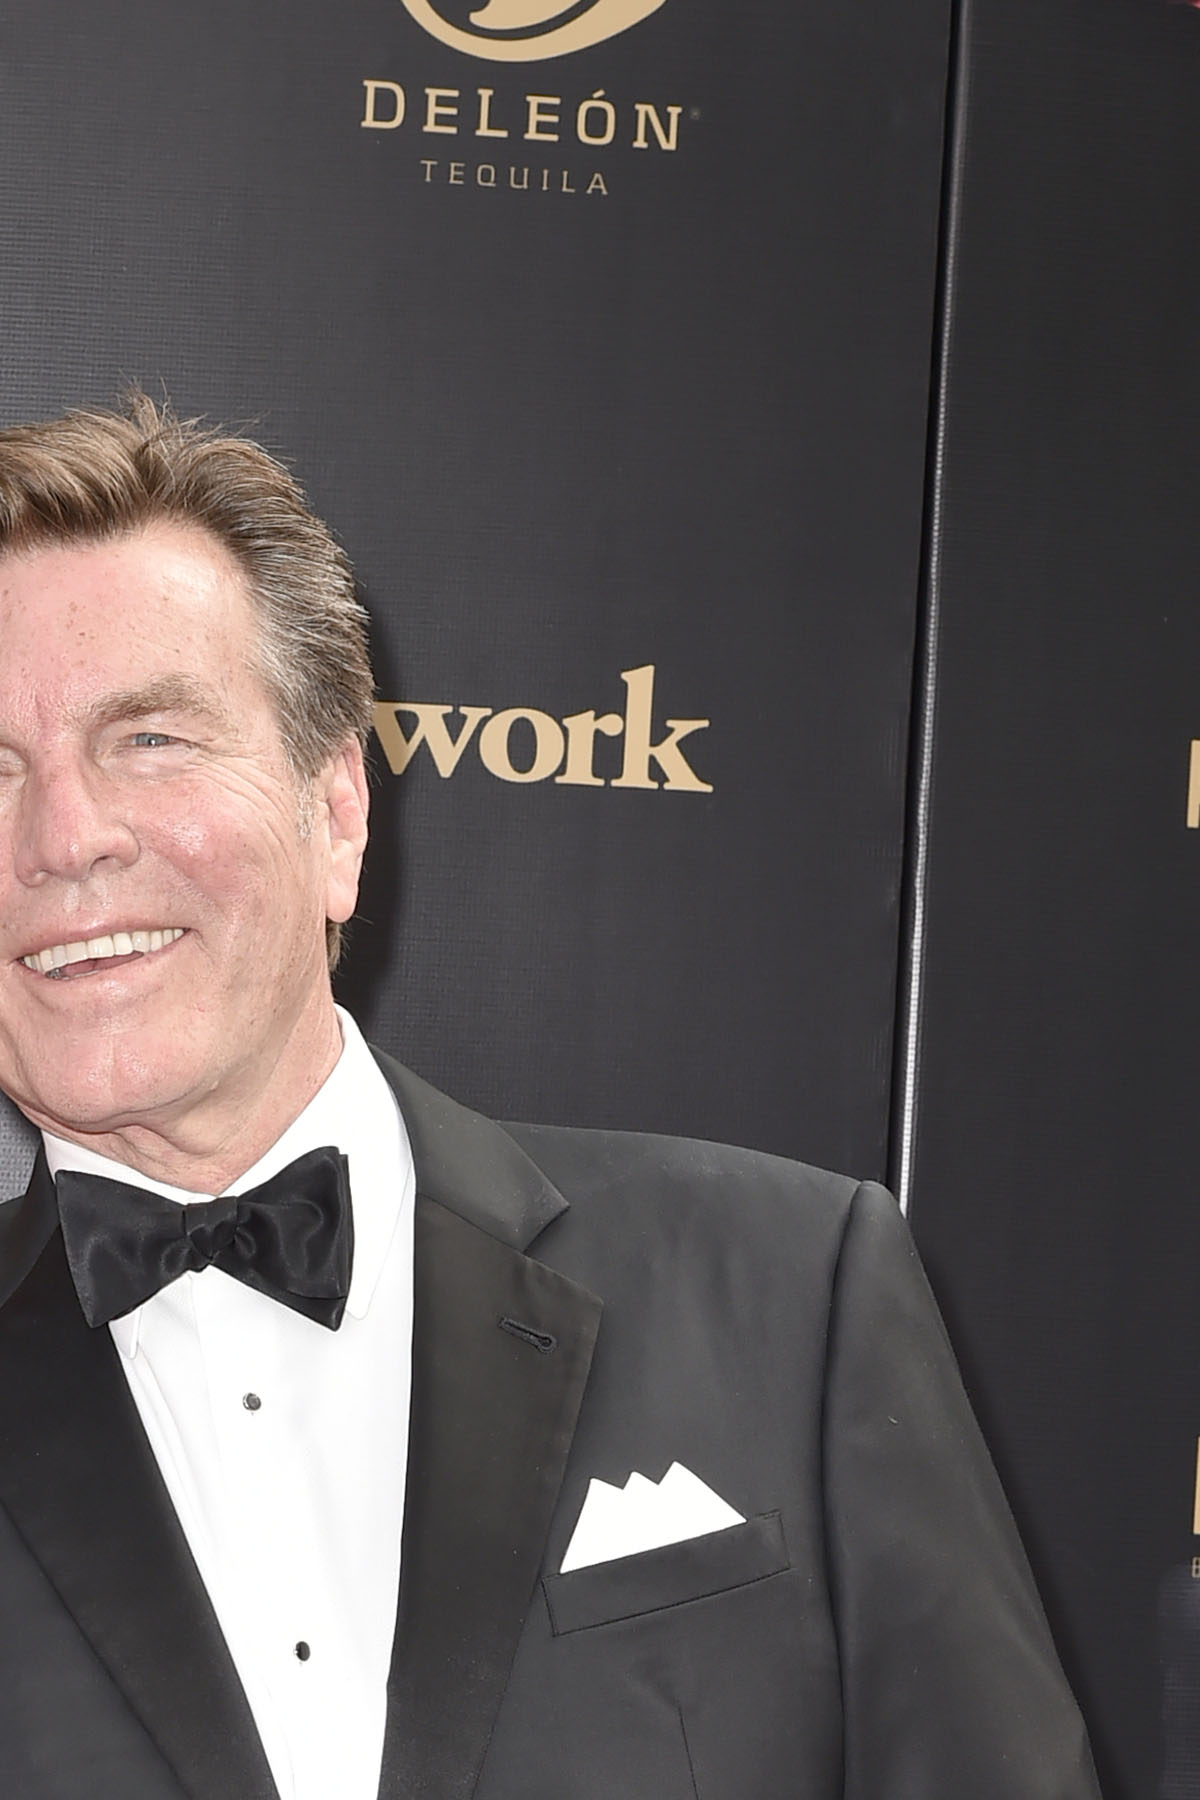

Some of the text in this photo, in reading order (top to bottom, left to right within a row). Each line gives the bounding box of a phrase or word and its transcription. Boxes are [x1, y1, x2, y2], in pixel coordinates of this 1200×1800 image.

[360, 79, 683, 151] DELEÓN
[420, 159, 609, 195] TEQUILA
[373, 665, 714, 793] work
